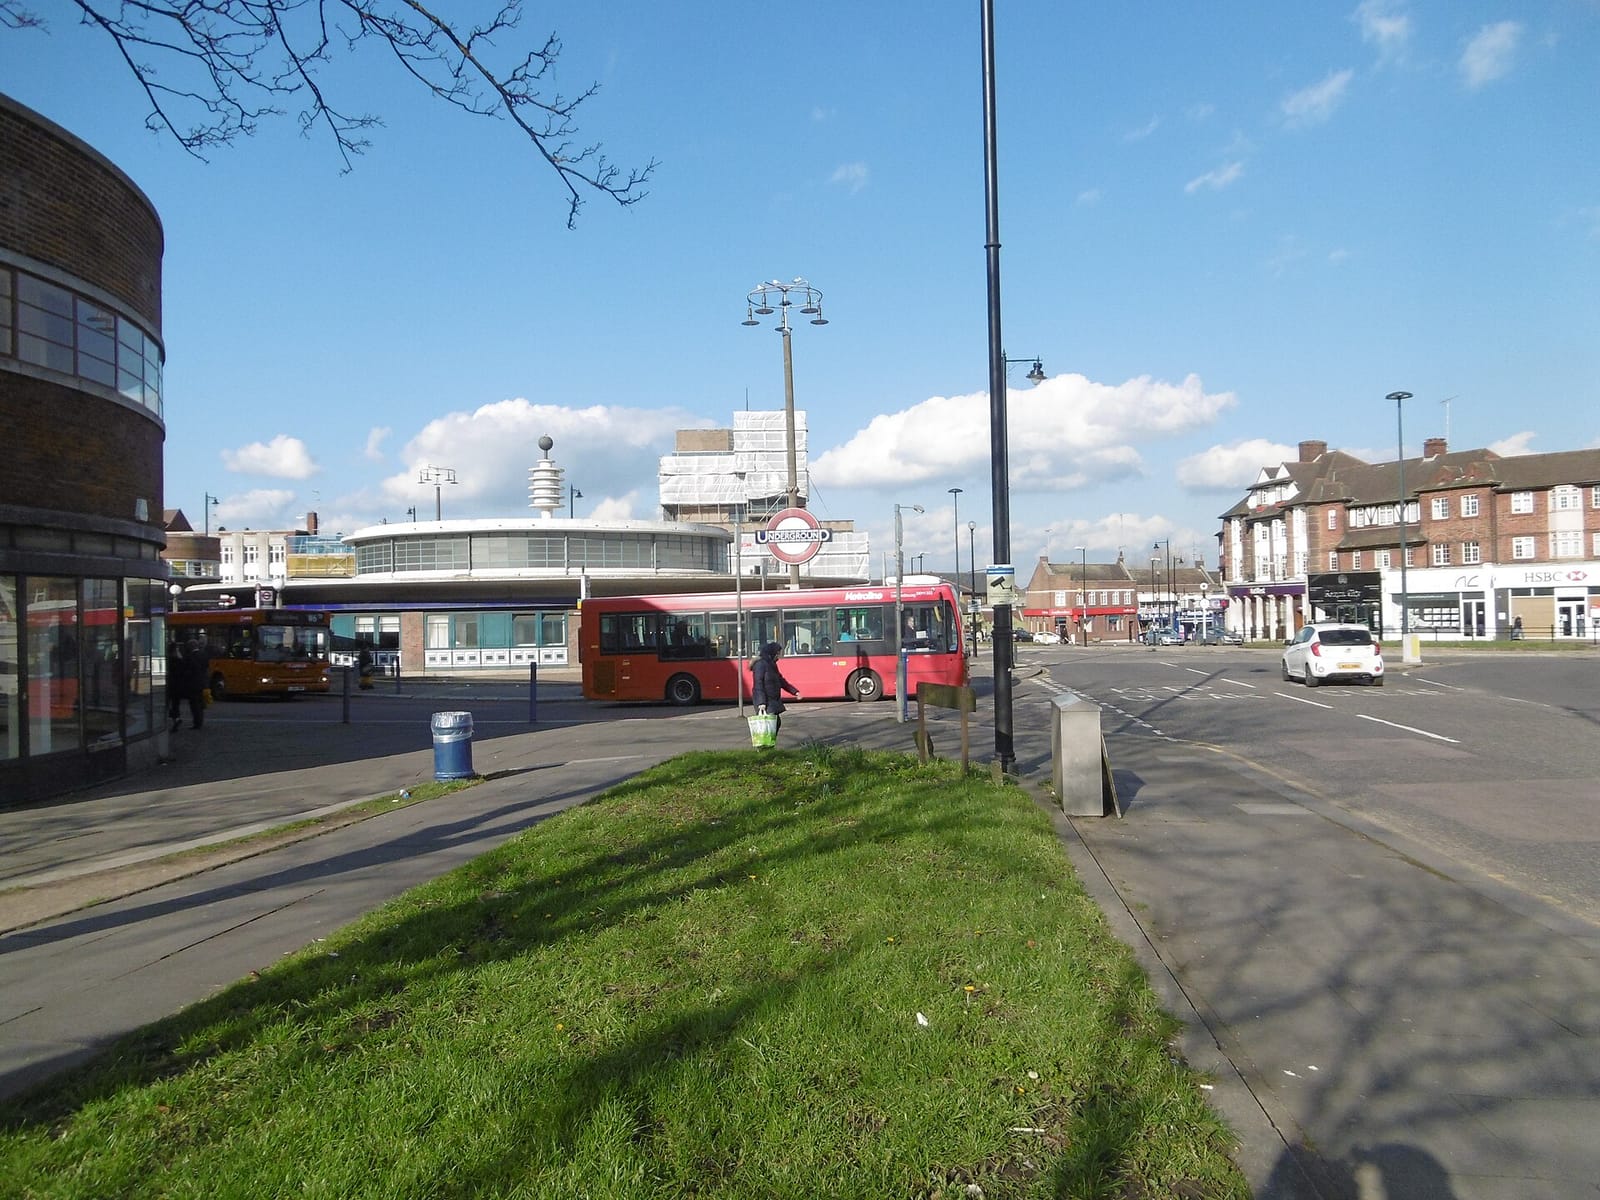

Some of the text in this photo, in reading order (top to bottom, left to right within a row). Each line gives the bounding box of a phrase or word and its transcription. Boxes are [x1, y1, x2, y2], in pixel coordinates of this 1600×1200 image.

[757, 529, 830, 543] UNDERGROUND
[1524, 571, 1563, 583] HSBC
[844, 591, 883, 600] Metroline
